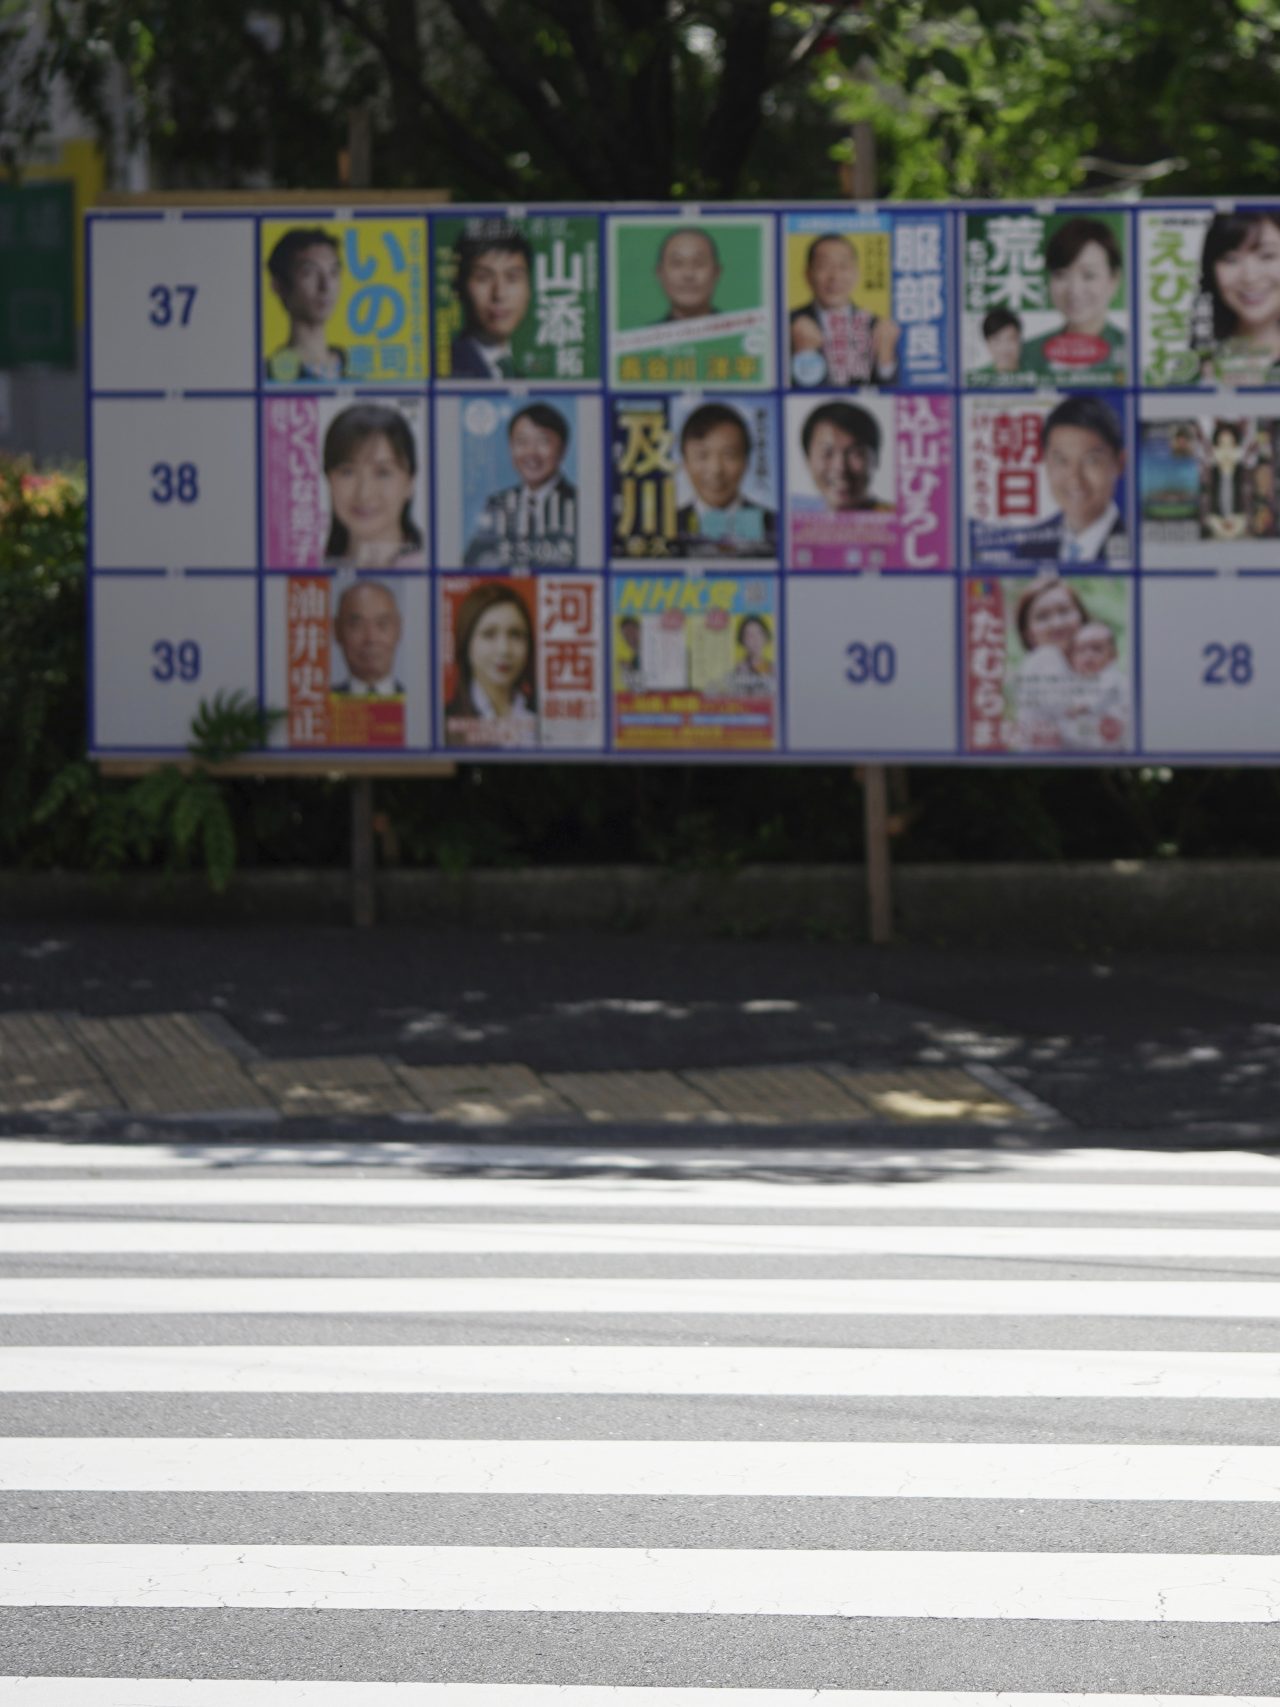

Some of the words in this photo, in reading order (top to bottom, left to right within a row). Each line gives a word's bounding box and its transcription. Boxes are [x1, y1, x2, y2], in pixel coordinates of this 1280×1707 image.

[149, 285, 197, 328] 37
[344, 227, 405, 341] いの
[535, 239, 585, 378] 山添拓
[985, 215, 1046, 309] 荒木
[1148, 230, 1200, 382] えびさわ
[150, 463, 199, 504] 38
[616, 412, 677, 540] 及川
[899, 395, 941, 567] 込山ひろし
[992, 414, 1042, 517] 朝日
[150, 641, 201, 683] 39
[544, 583, 597, 691] 河西
[845, 643, 896, 685] 30
[1202, 643, 1254, 687] 28
